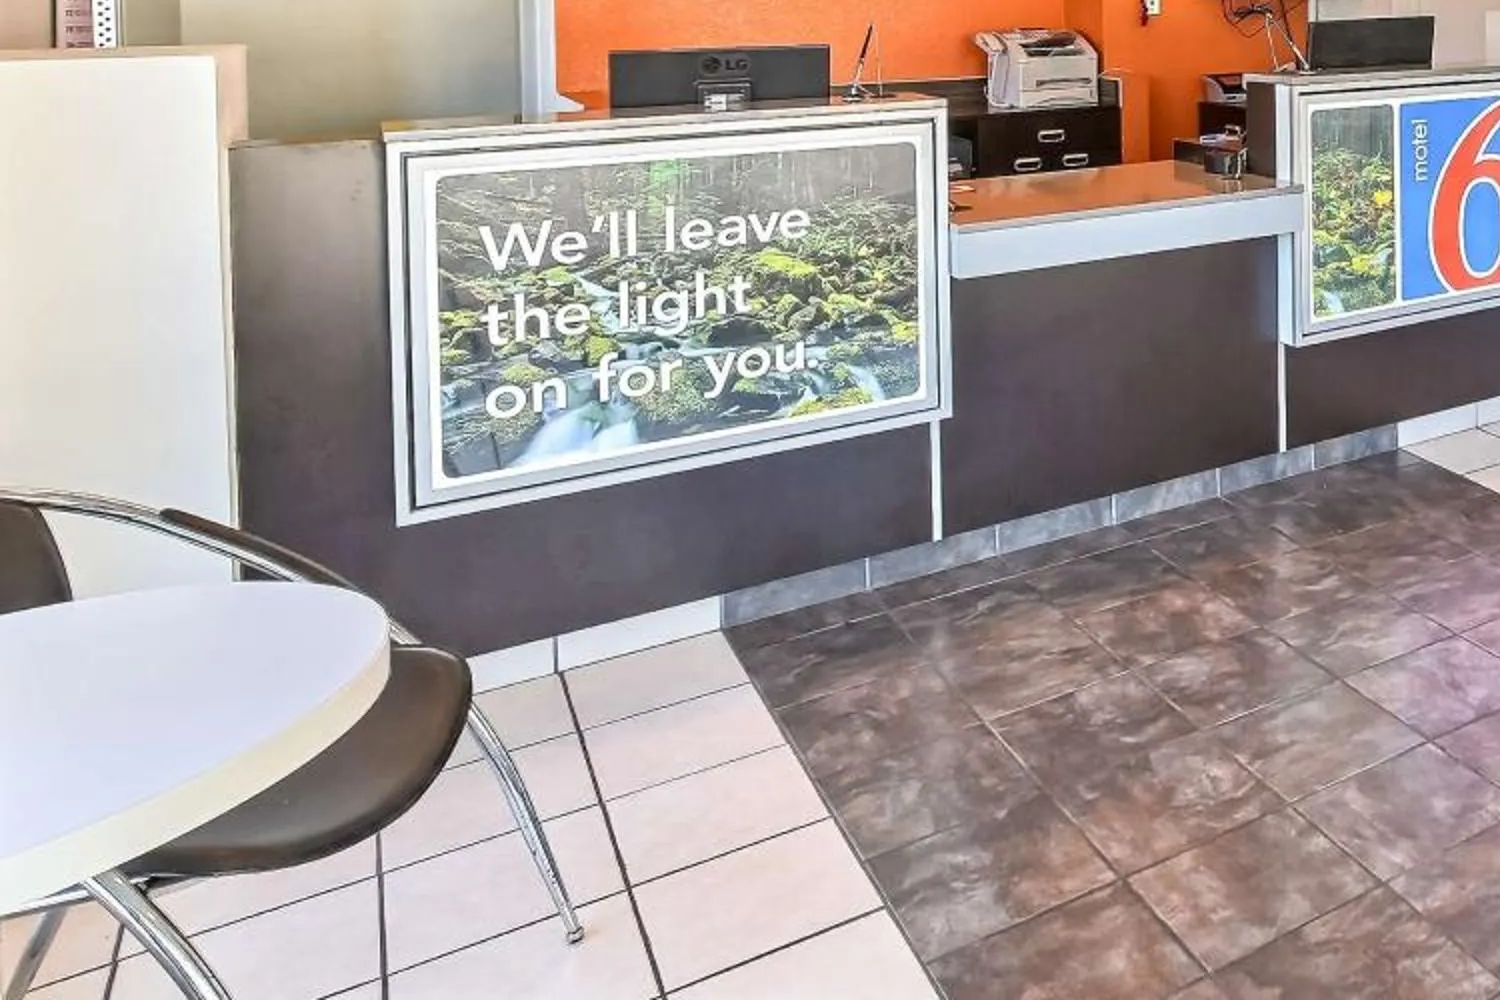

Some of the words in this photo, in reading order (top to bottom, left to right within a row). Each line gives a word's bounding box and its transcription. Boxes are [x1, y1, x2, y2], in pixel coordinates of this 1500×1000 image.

[725, 58, 748, 71] LG
[1411, 118, 1428, 183] motel
[479, 208, 638, 271] We'll
[665, 204, 811, 254] leave
[482, 292, 592, 347] the
[618, 269, 754, 337] light
[485, 376, 568, 420] on
[598, 351, 686, 403] for
[703, 340, 821, 400] you.
